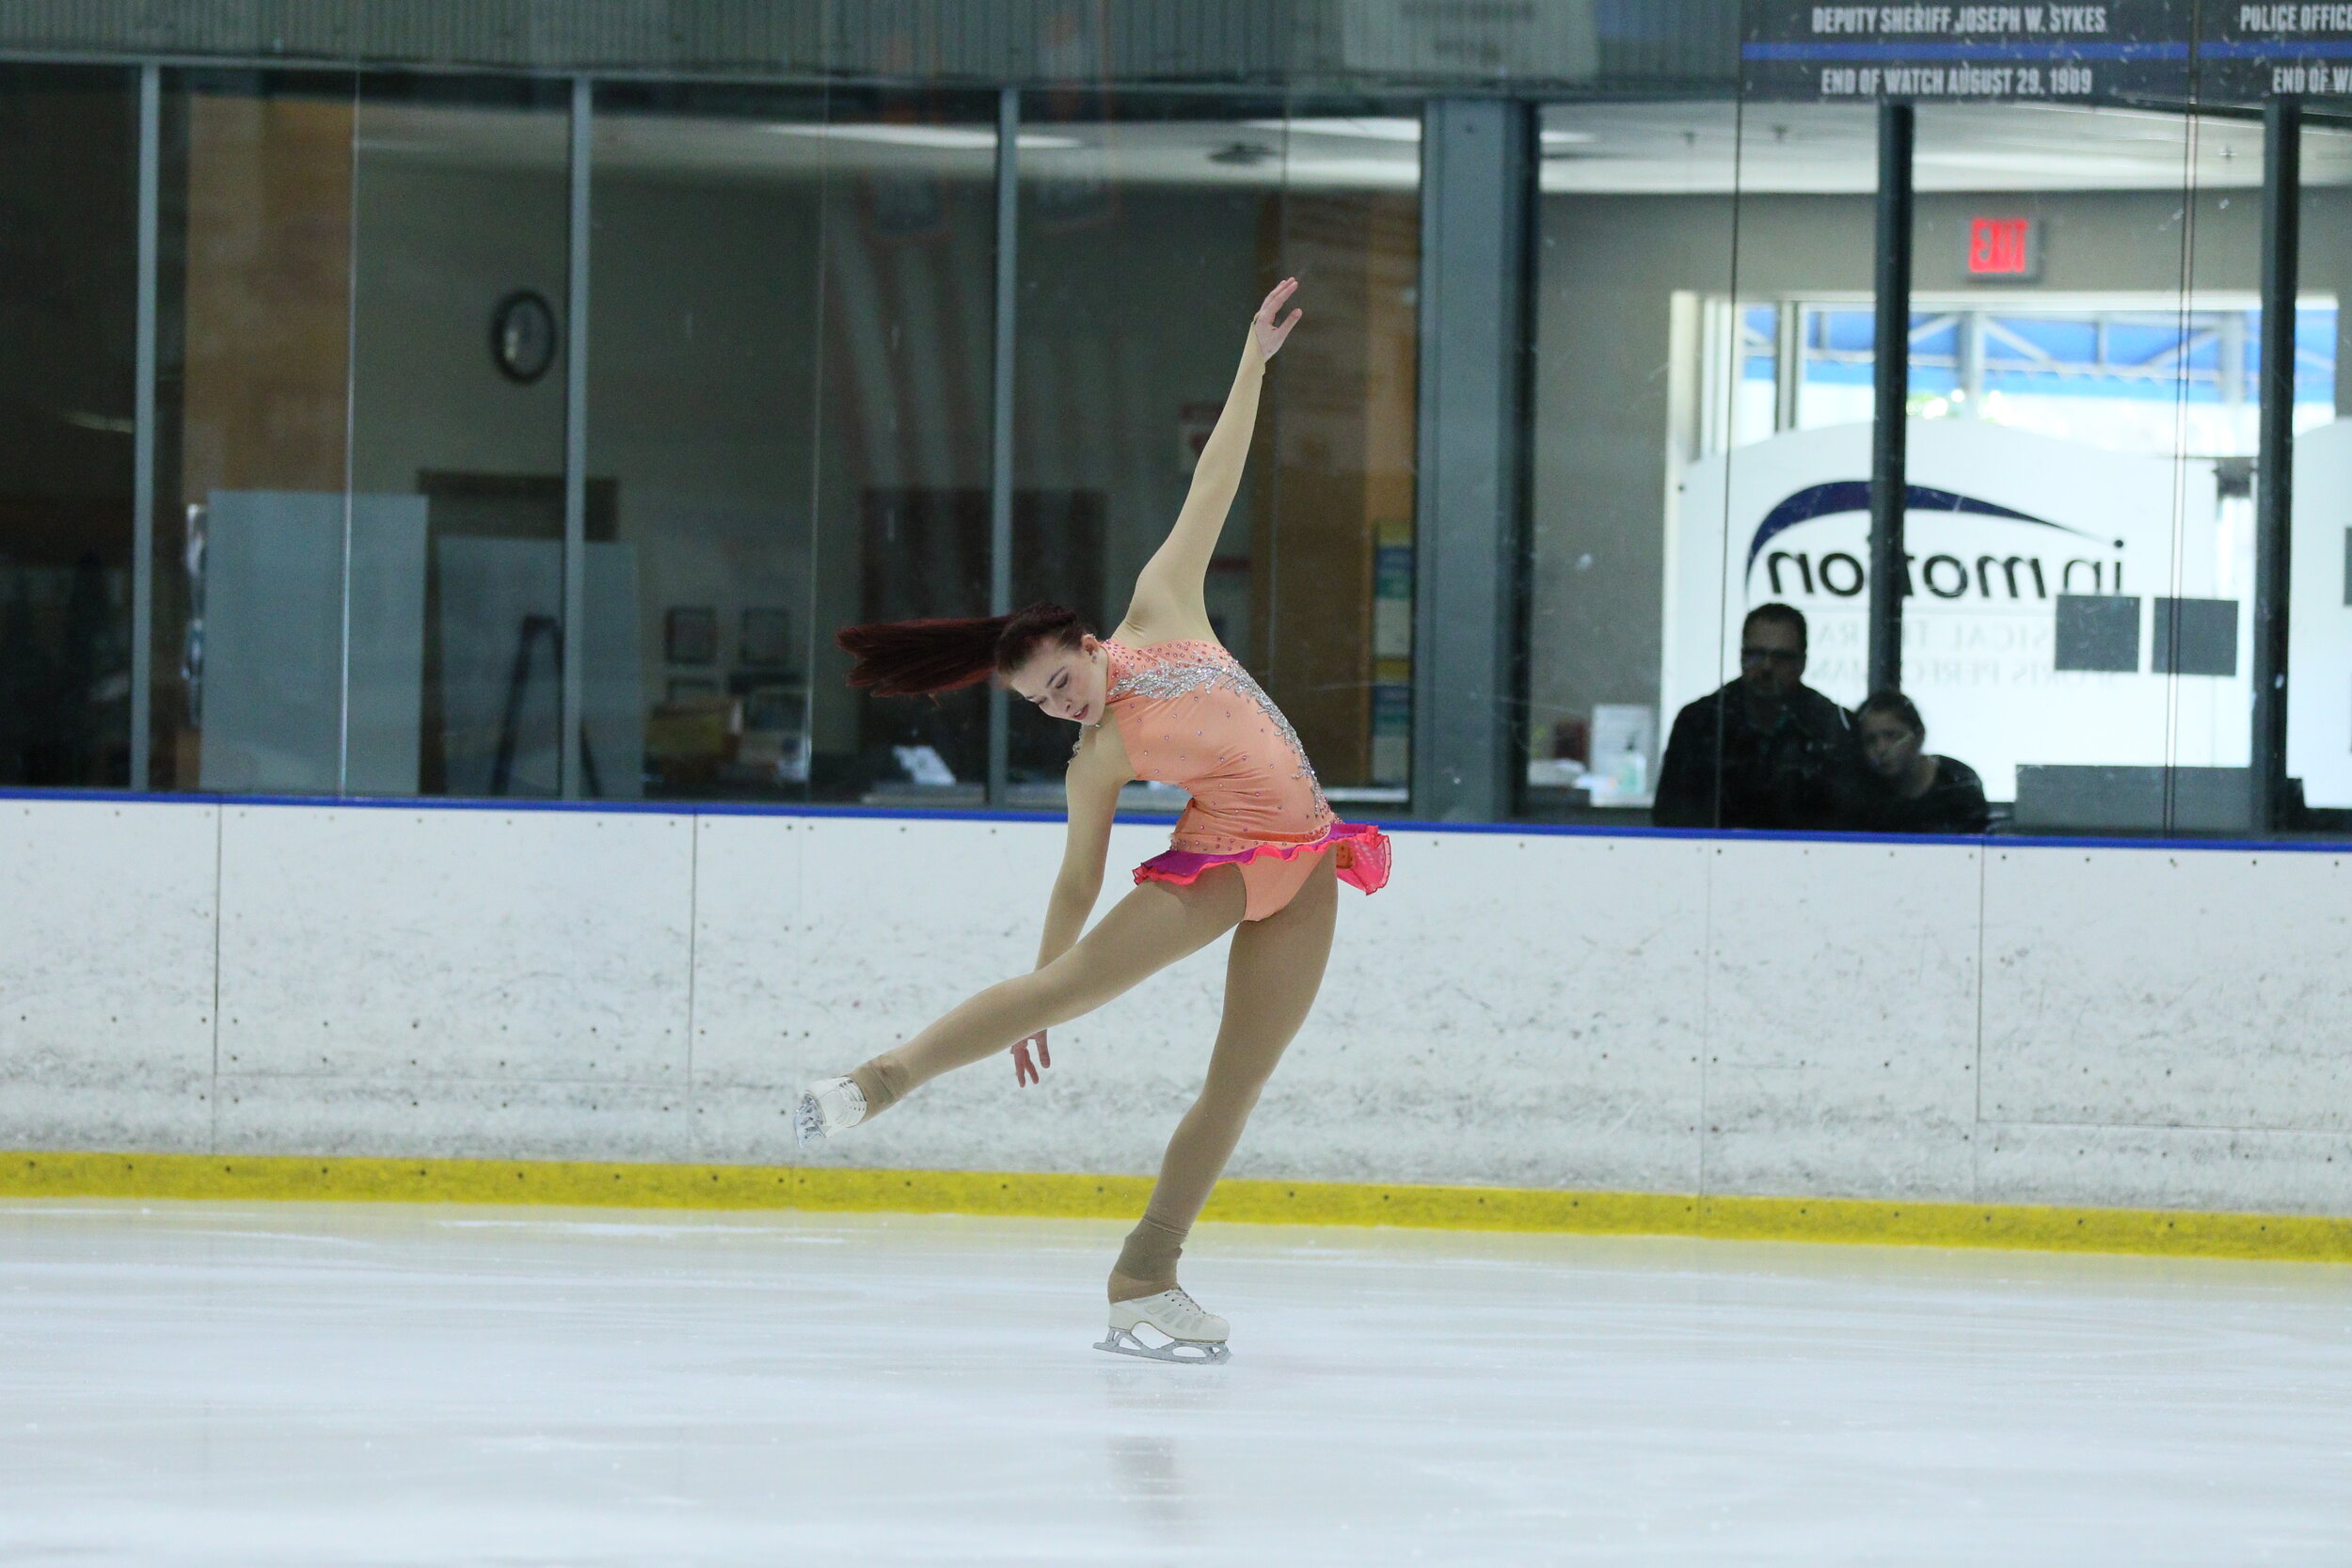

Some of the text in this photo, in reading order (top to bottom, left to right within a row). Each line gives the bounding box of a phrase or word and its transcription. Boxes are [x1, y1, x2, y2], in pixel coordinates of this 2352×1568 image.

[1812, 7, 2107, 34] DEPUTY SHERIFF JOSEPH W. SYKES
[2240, 5, 2297, 32] POLICE
[1821, 68, 1856, 95] END
[1859, 68, 1881, 95] OF
[1884, 68, 1944, 95] WATCH
[1947, 68, 2013, 95] AUGUST
[2272, 68, 2306, 94] END
[2308, 68, 2329, 95] OF
[1969, 217, 2027, 273] EXIT
